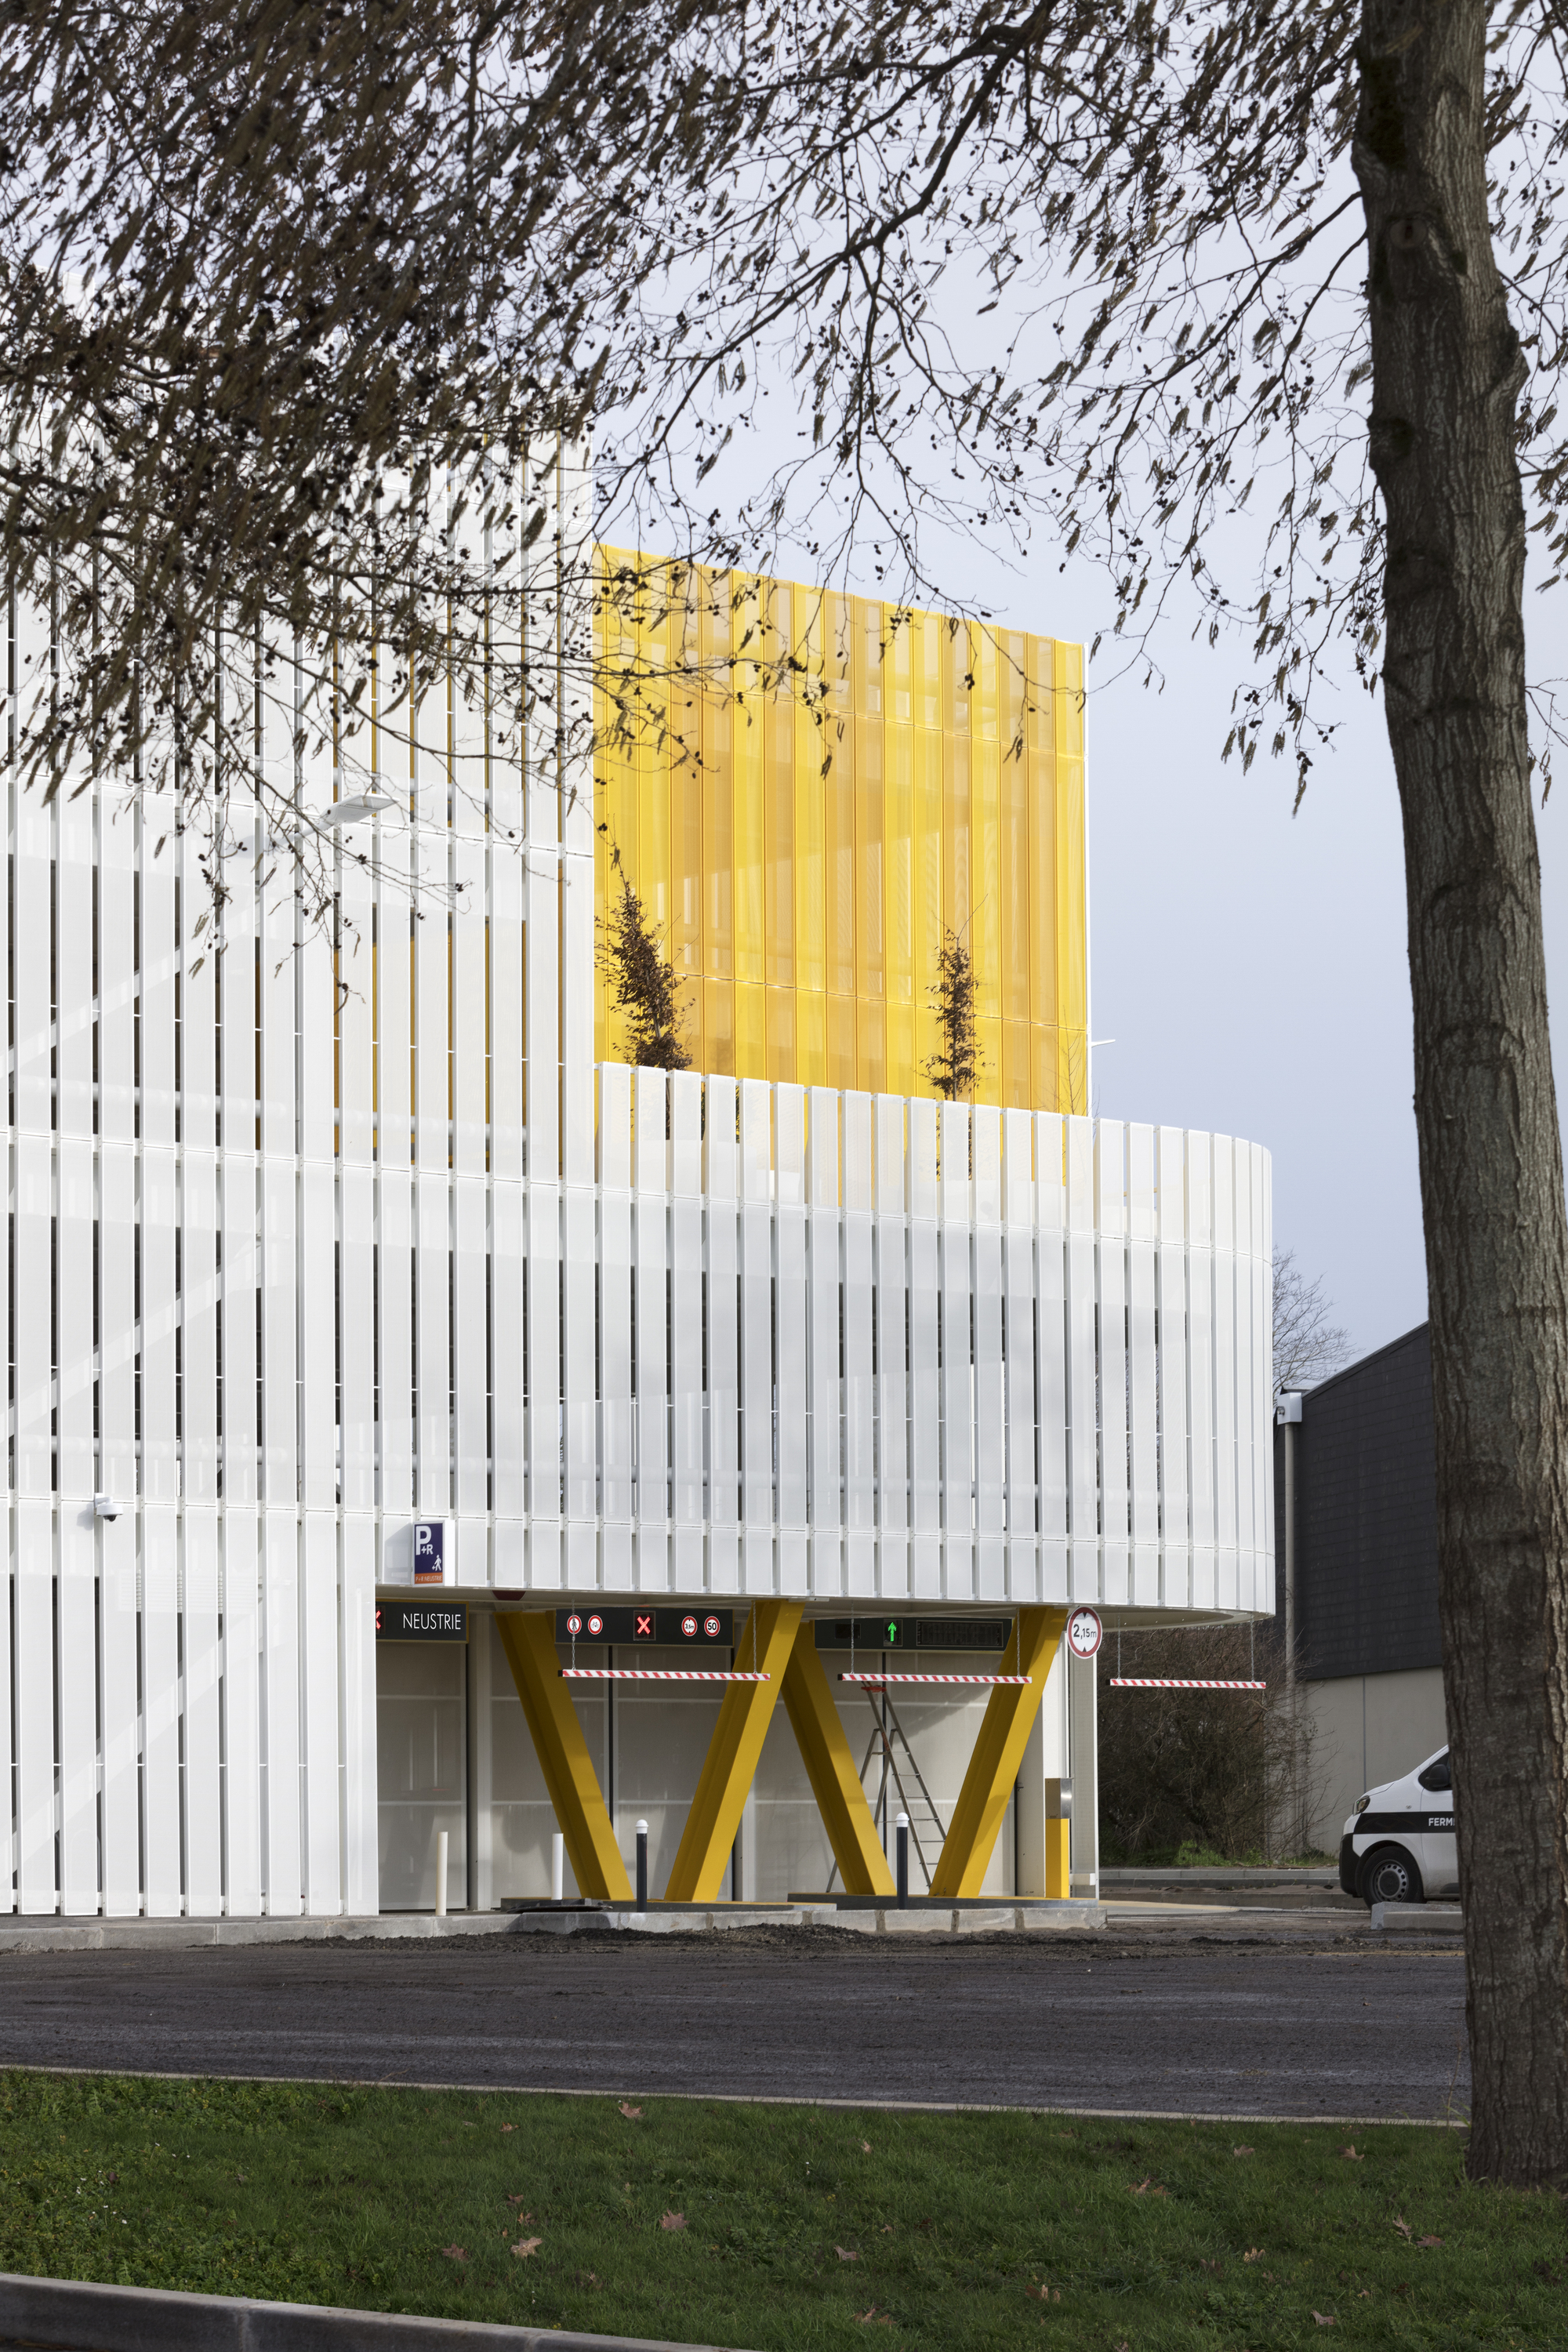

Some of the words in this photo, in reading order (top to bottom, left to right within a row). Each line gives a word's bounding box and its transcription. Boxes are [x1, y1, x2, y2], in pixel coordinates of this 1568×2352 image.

[403, 1613, 461, 1630] NEUSTRIE
[707, 1622, 717, 1631] 50
[1073, 1624, 1097, 1640] 2,15m
